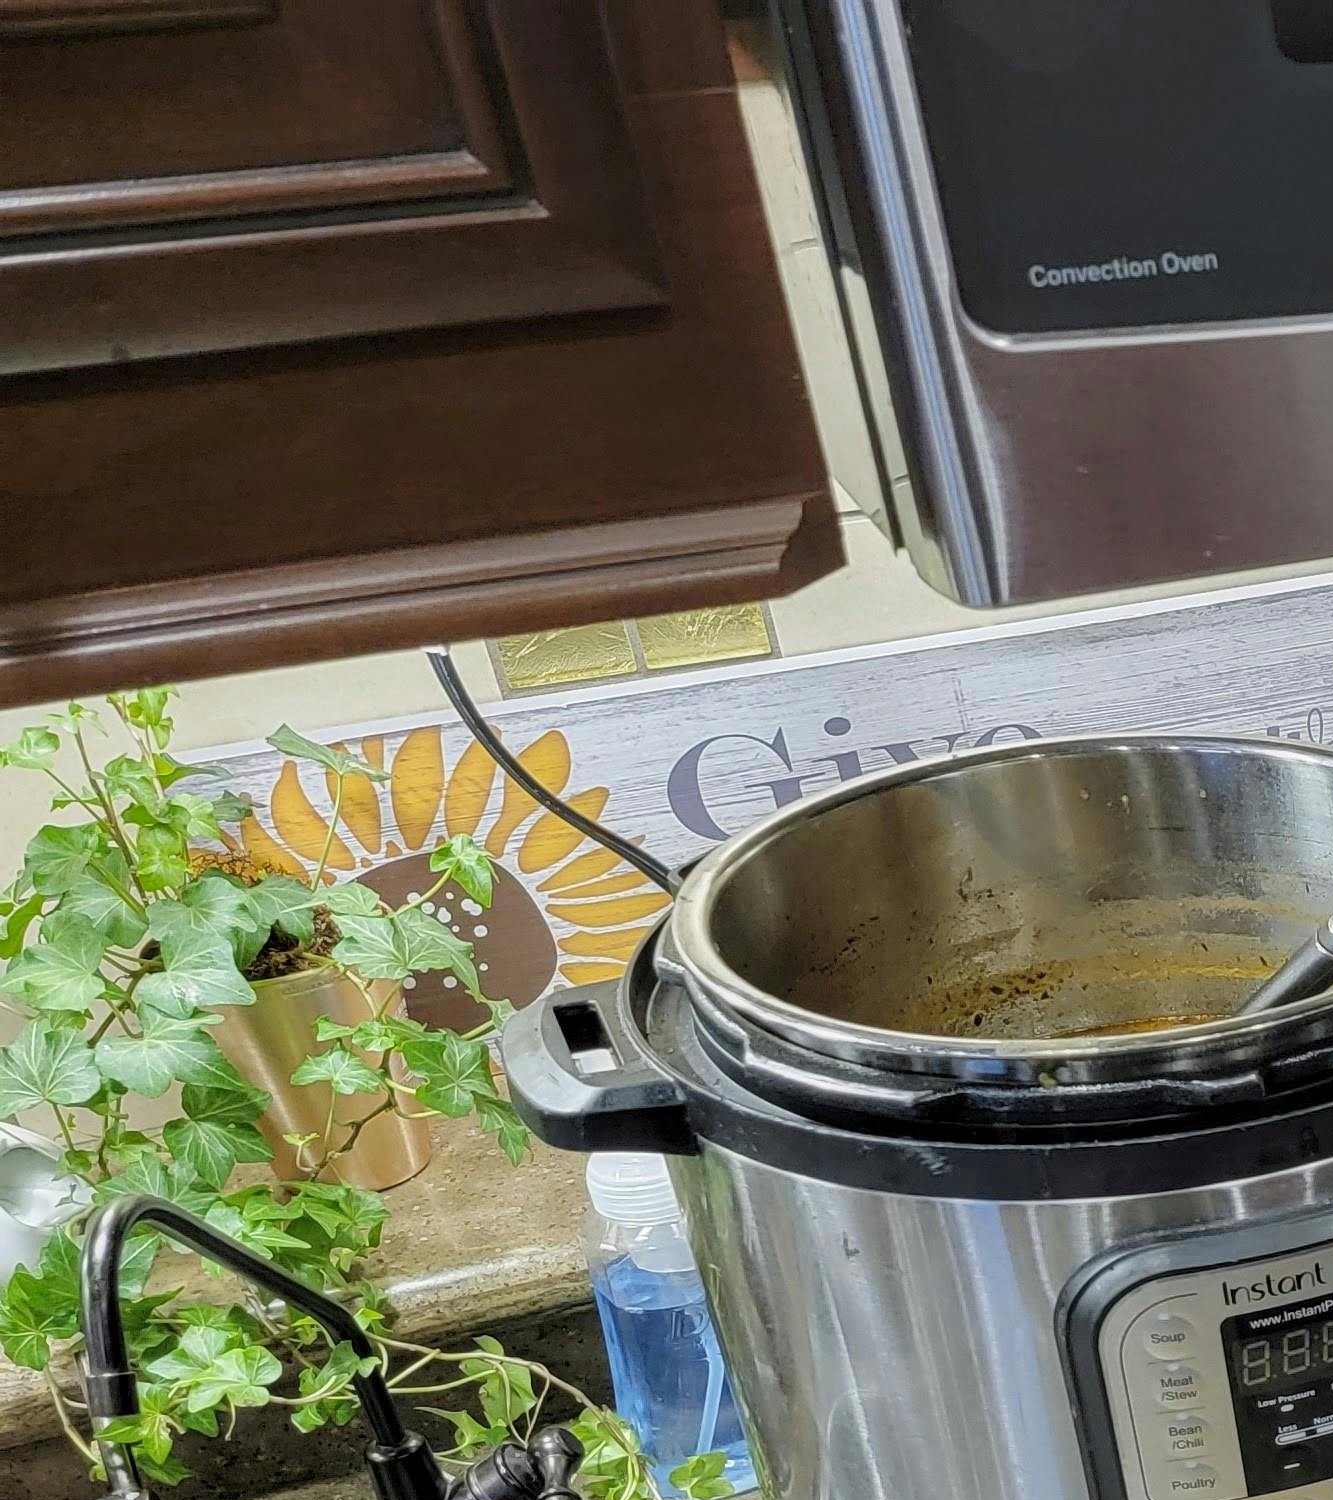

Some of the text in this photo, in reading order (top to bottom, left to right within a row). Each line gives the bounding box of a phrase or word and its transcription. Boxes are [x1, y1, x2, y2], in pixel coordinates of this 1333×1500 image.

[1028, 251, 1219, 288] Convection Oven
[1221, 1262, 1327, 1306] Instant
[1150, 1332, 1186, 1345] Soup
[1160, 1375, 1194, 1388] Meat
[1161, 1389, 1198, 1402] /Stew
[1258, 1389, 1316, 1409] Low Pressure
[1168, 1425, 1203, 1438] Bean
[1278, 1423, 1298, 1434] Less
[1171, 1477, 1216, 1491] Poultry
